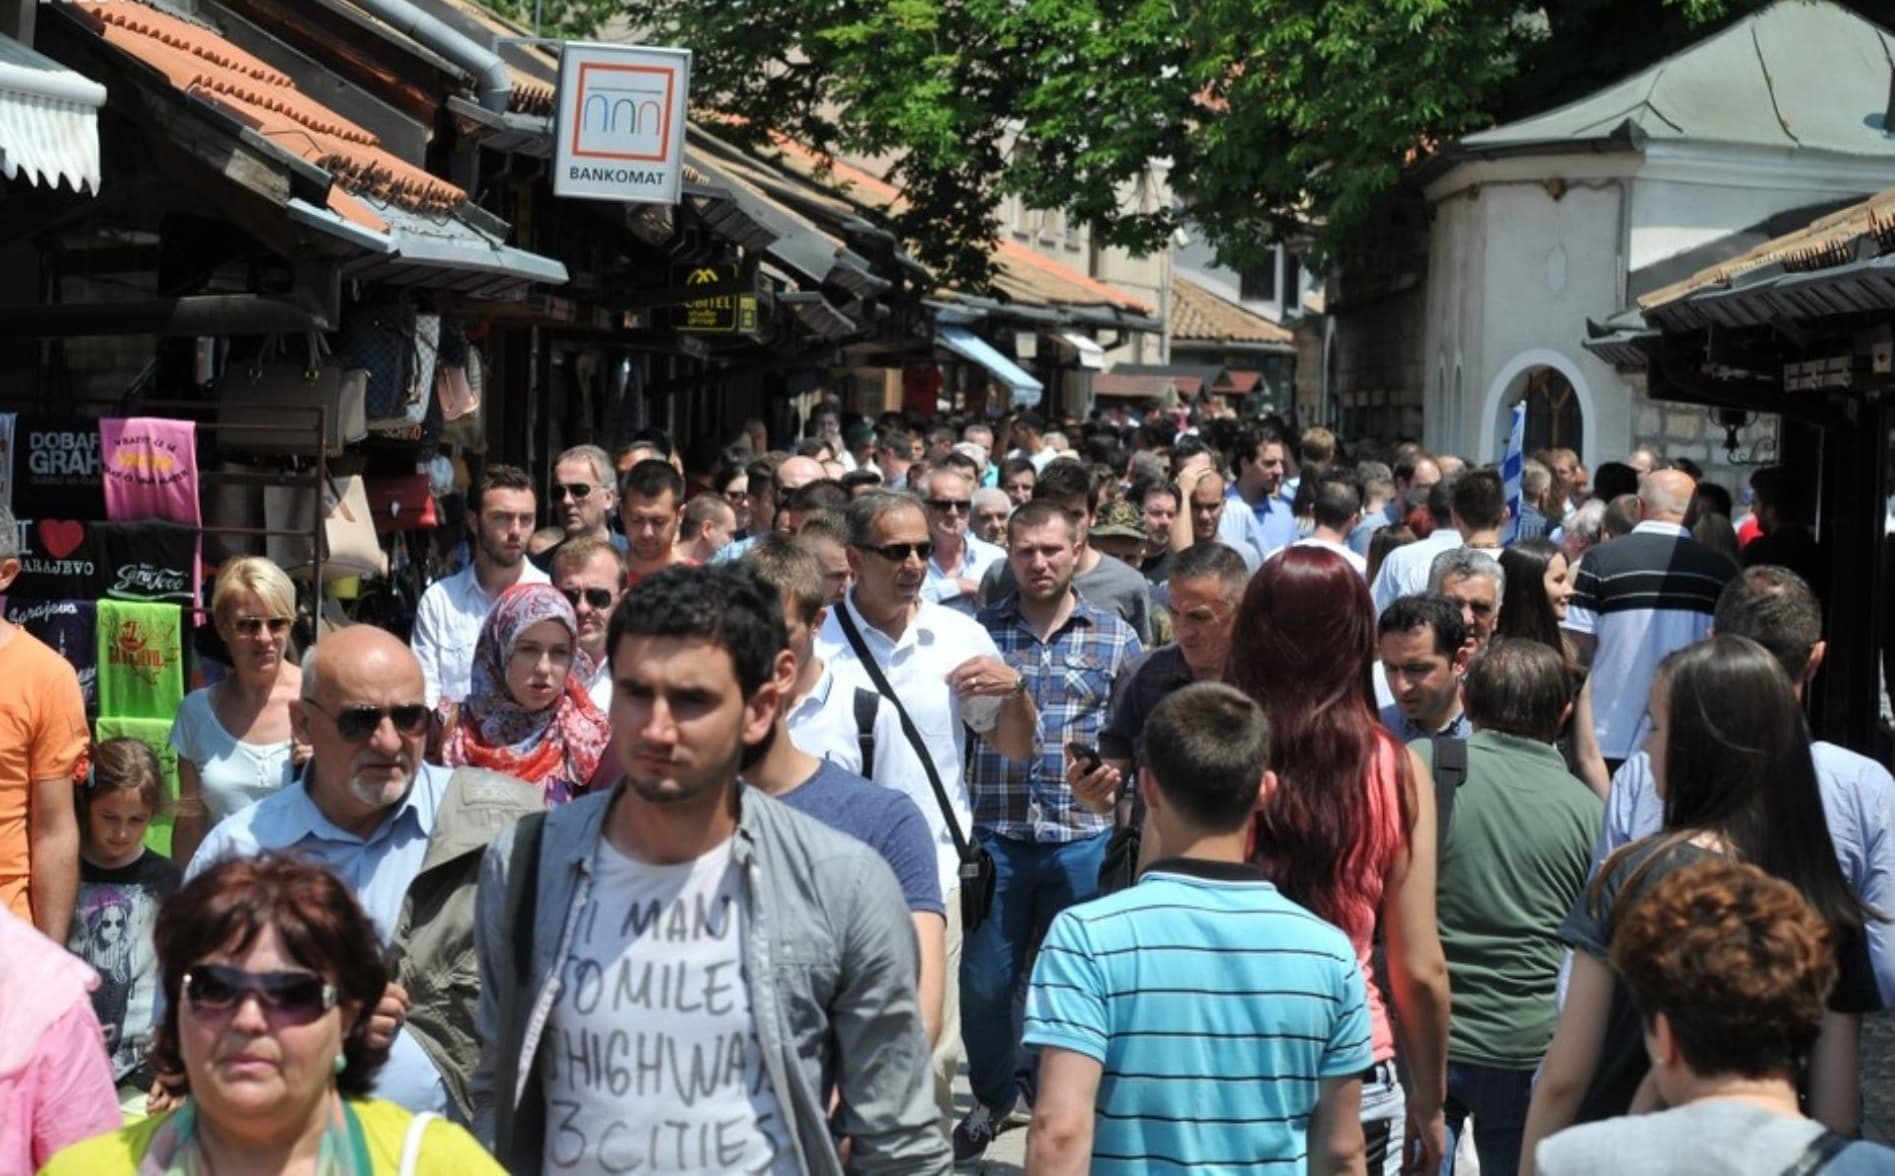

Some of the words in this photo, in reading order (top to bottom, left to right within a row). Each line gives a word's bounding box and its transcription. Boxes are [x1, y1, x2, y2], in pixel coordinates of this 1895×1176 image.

[569, 166, 665, 185] BANKOMAT
[17, 519, 33, 554] I
[20, 558, 95, 576] ARAJEVO
[619, 891, 734, 942] MAN
[612, 956, 754, 1017] MILE
[597, 1111, 780, 1176] CITIES
